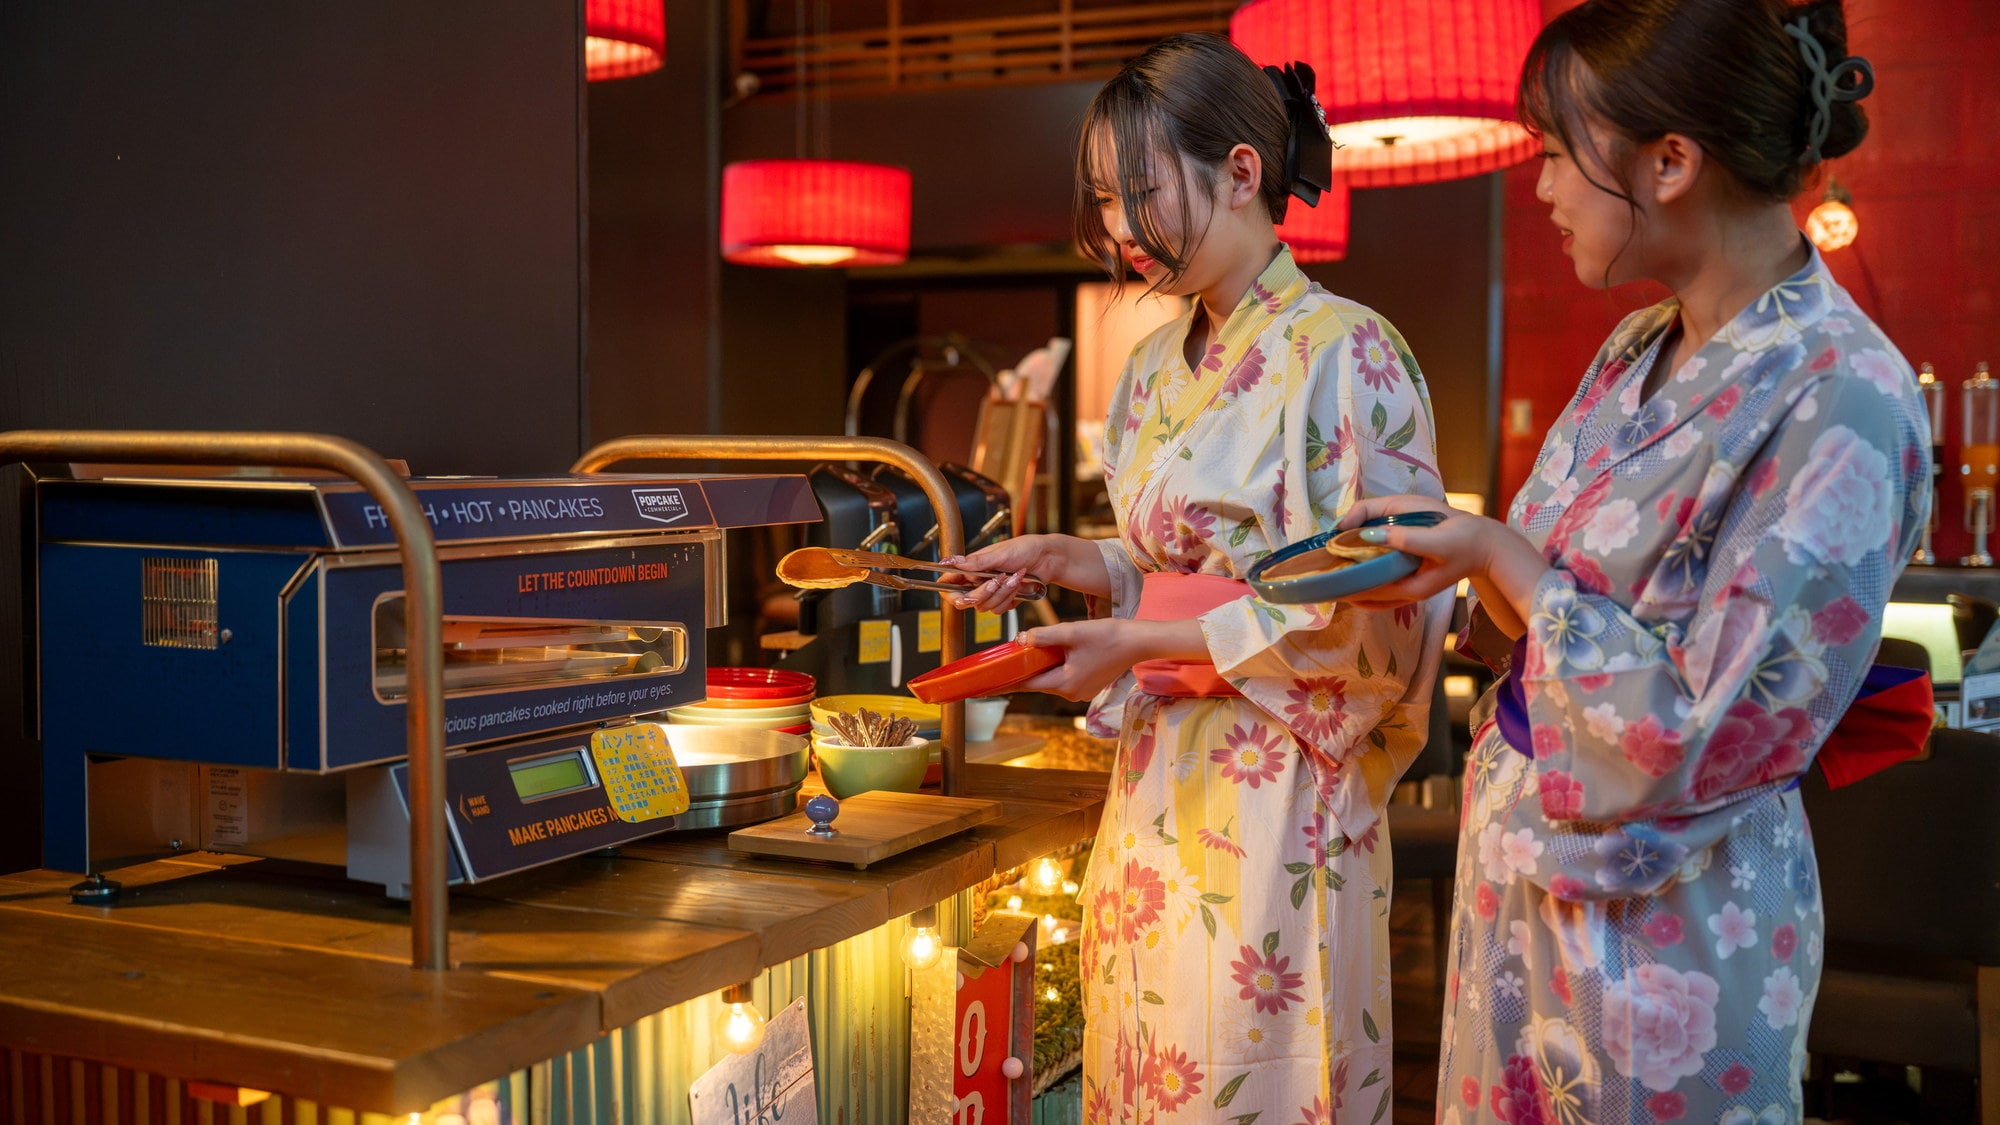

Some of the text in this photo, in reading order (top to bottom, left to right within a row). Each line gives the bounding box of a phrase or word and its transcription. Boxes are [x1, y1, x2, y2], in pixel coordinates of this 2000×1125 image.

[451, 501, 493, 523] HOT
[507, 497, 604, 520] PANCAKES
[638, 495, 681, 506] POPCAKE
[518, 562, 668, 593] LET THE COUNTDOWN BEGIN
[444, 683, 673, 733] icious pancakes cooked right before your eyes.
[508, 822, 547, 846] MAKE
[545, 807, 608, 837] PANCAKES
